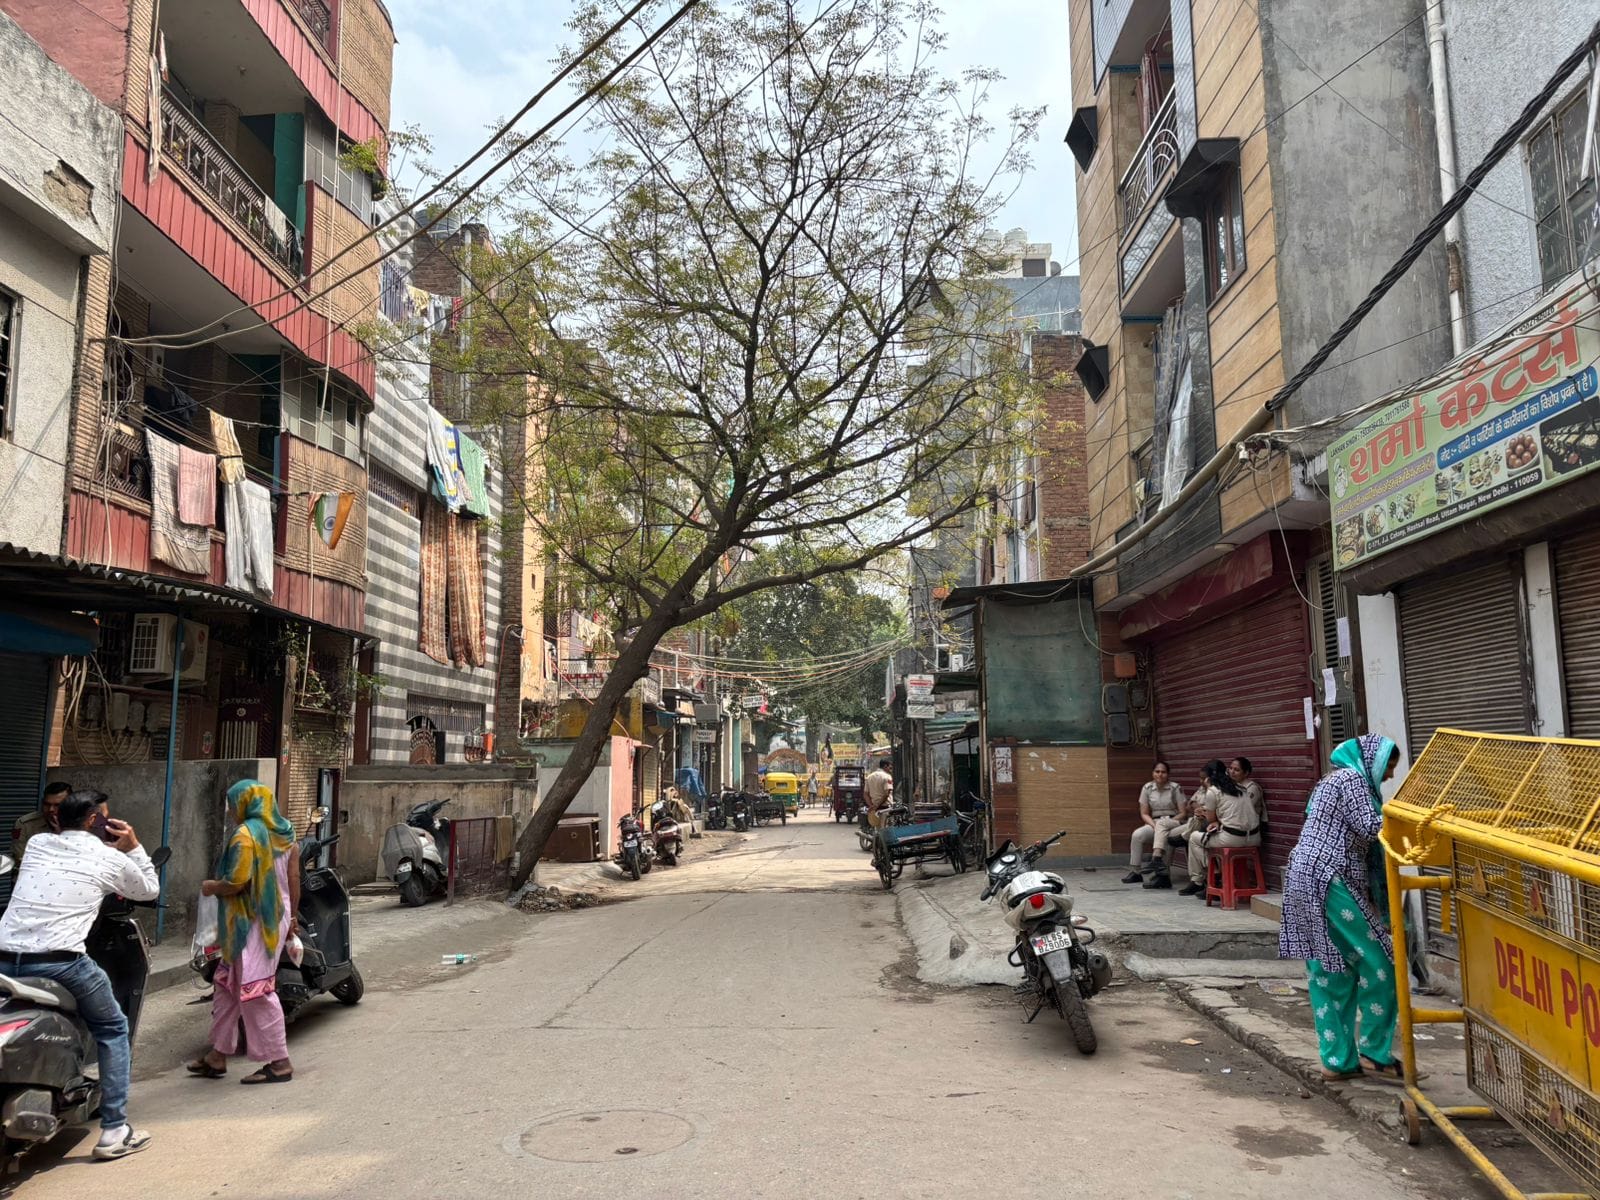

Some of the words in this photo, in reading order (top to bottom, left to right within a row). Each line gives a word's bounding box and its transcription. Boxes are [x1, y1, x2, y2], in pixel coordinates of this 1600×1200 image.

[1348, 394, 1428, 484] शर्मा
[1478, 494, 1492, 504] New
[1493, 484, 1509, 497] Delhi
[1514, 472, 1539, 488] 110059
[1494, 937, 1554, 1016] DELHI
[1561, 968, 1600, 1048] PO
